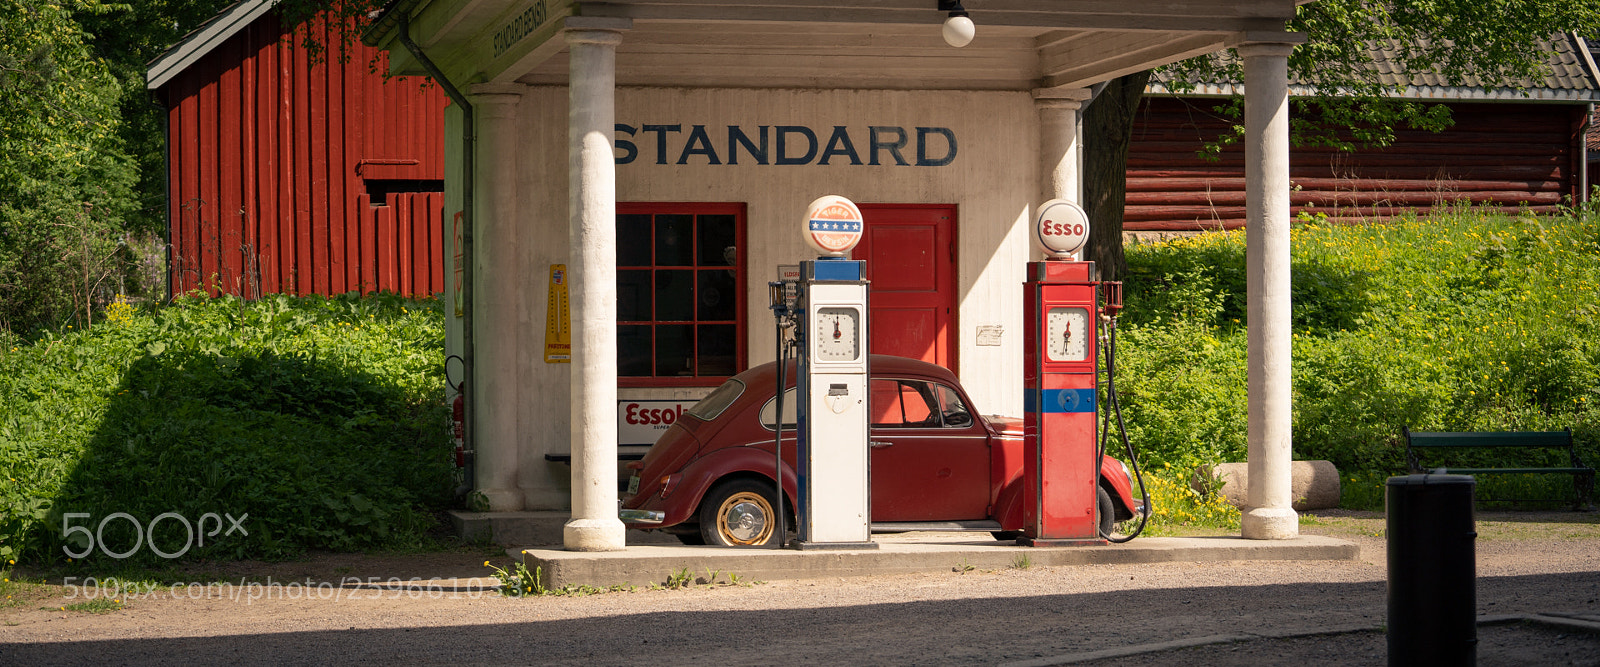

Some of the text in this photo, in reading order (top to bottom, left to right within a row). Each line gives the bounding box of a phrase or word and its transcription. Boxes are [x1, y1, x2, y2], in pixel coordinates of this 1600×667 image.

[494, 0, 547, 58] STANDARD BENSIN
[614, 123, 958, 167] STANDARD
[821, 206, 850, 218] TIGER
[1042, 219, 1084, 236] Esso
[625, 402, 689, 425] Essol
